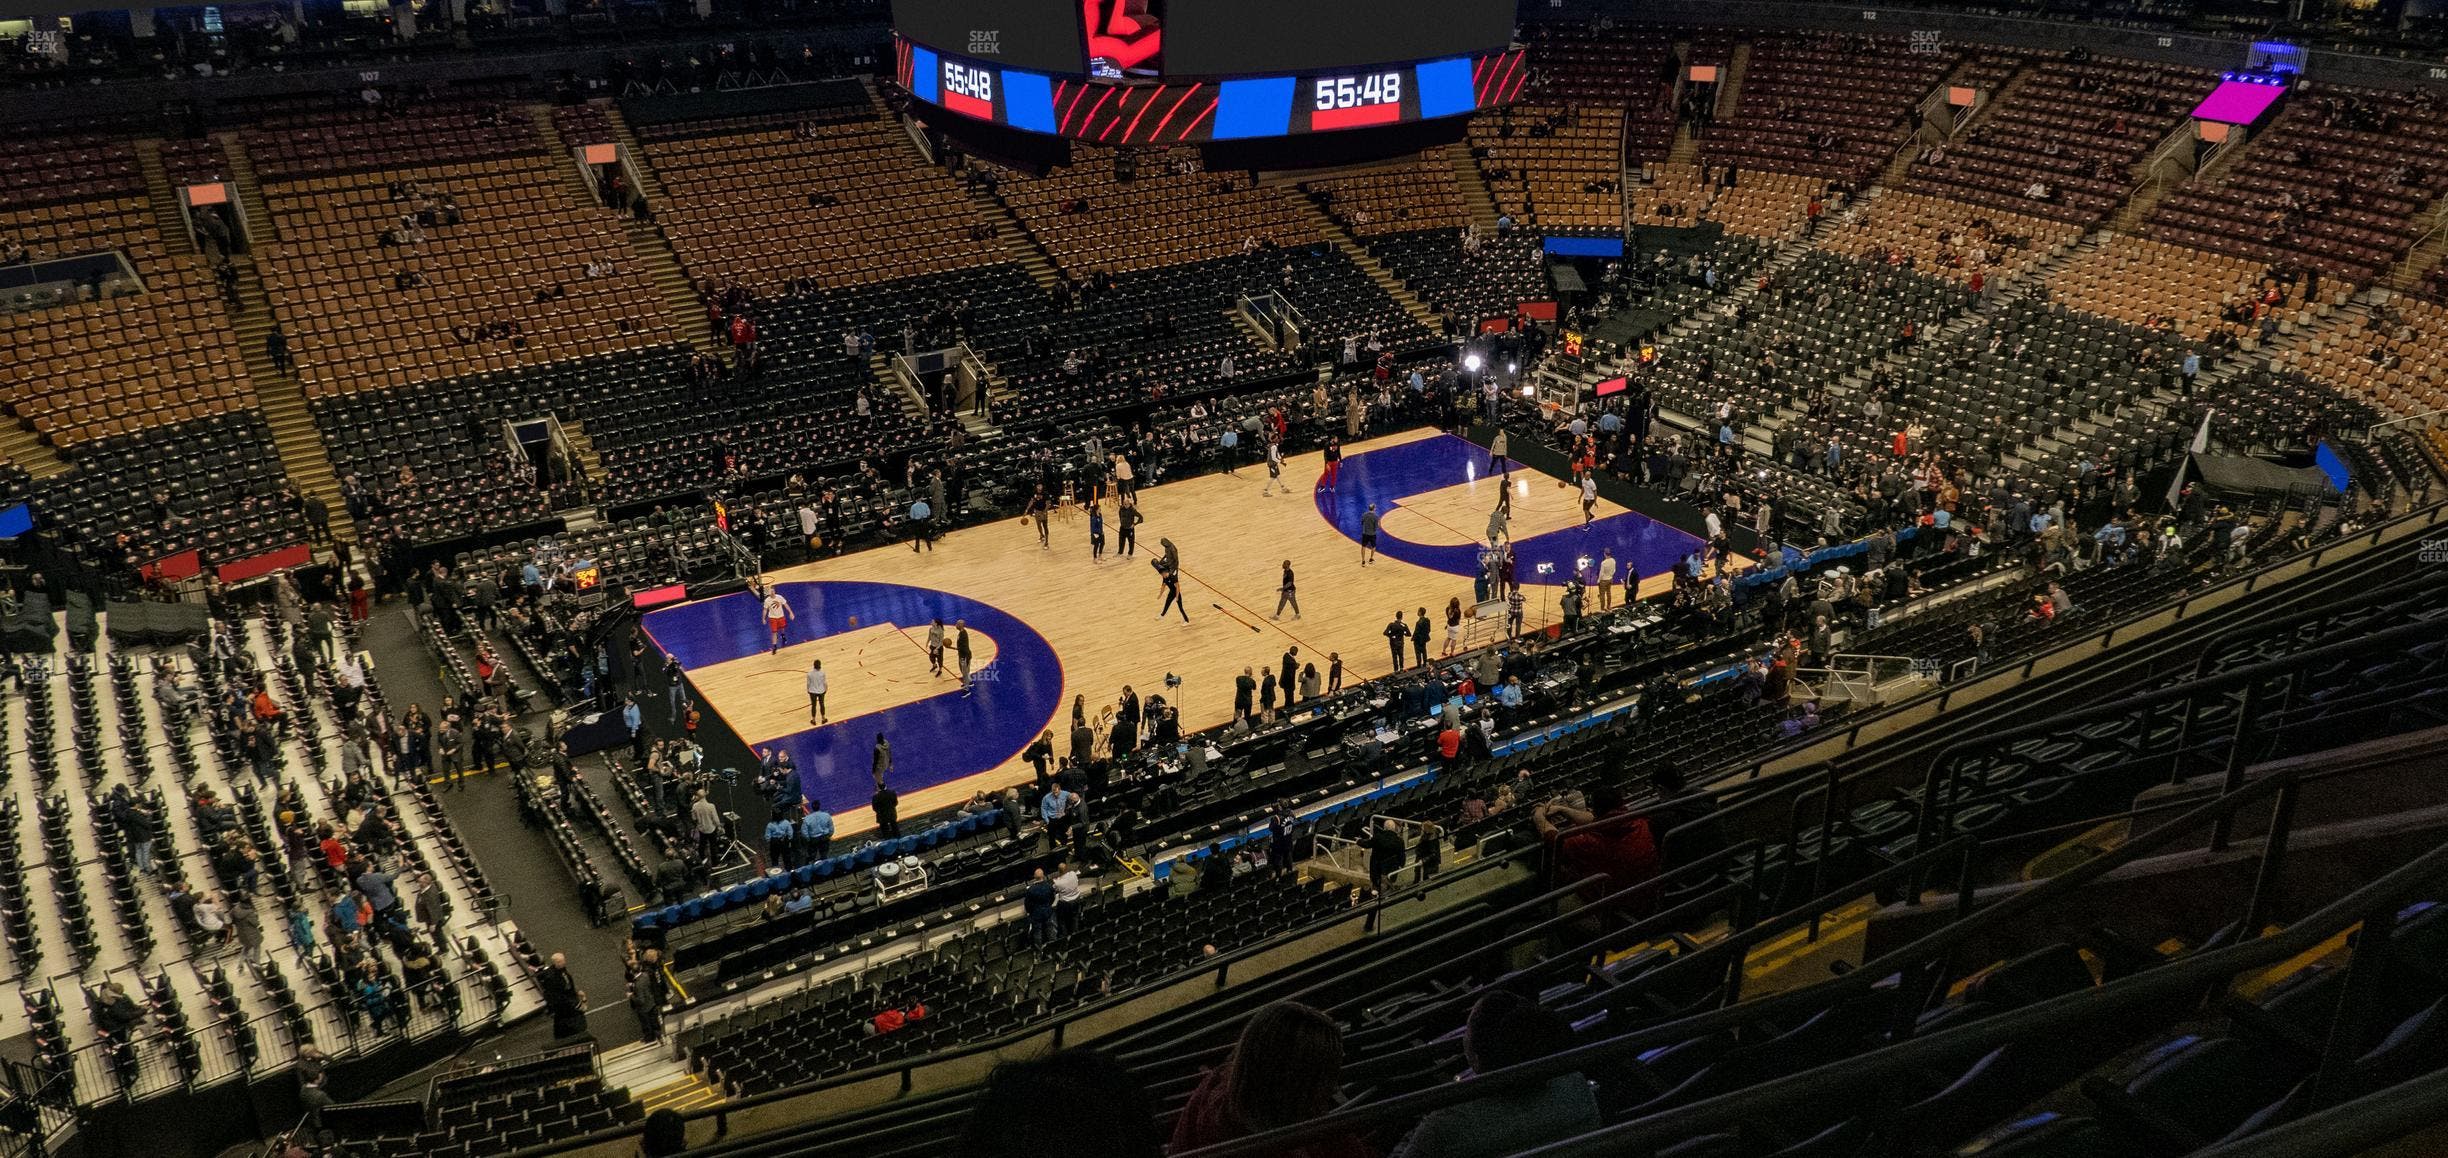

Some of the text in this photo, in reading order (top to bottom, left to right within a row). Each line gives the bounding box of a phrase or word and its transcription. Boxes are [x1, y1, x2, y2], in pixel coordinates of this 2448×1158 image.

[1863, 11, 1877, 20] 112
[2158, 37, 2172, 47] 113
[360, 71, 379, 82] 107
[945, 62, 992, 102] 55:48
[1316, 73, 1400, 111] 55:48
[1566, 341, 1580, 355] 24
